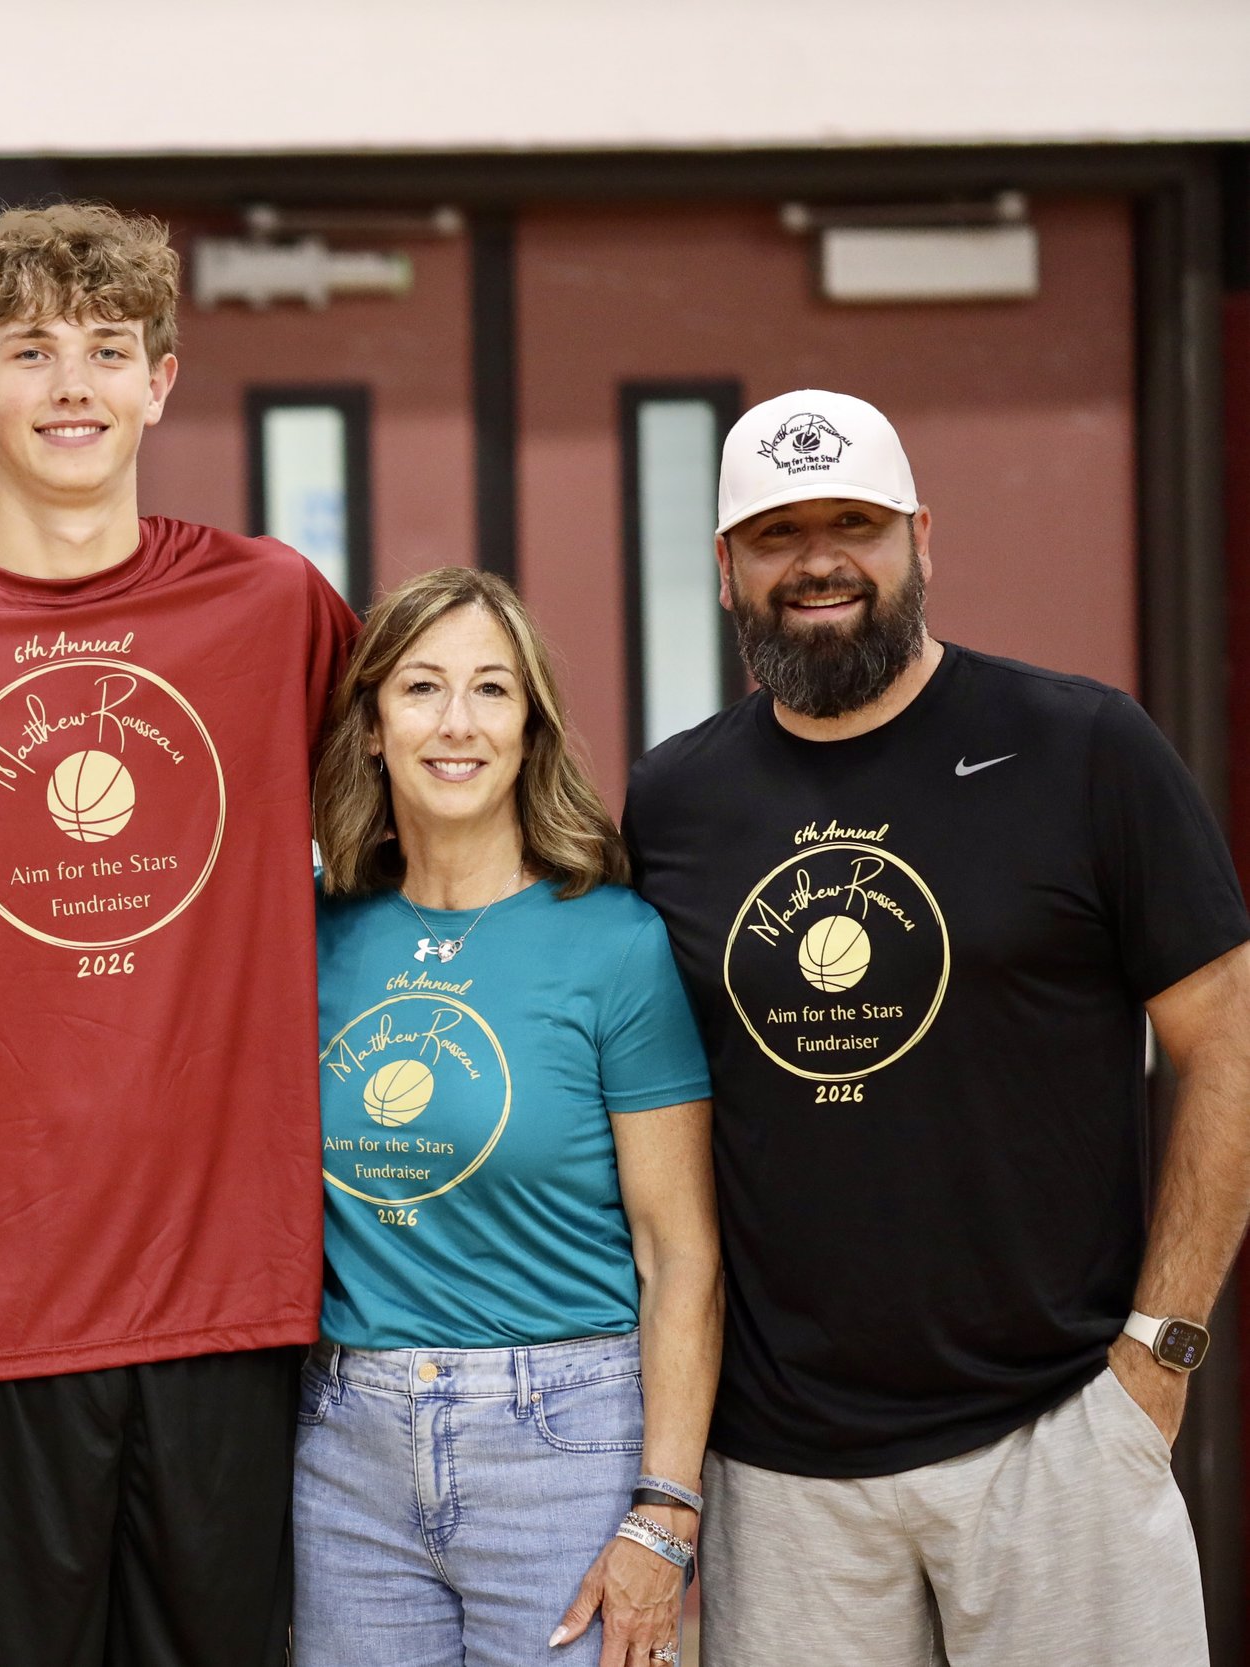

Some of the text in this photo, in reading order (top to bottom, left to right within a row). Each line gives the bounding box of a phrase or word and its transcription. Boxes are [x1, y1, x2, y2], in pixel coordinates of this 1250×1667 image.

[776, 455, 840, 469] Aim for the Stars
[788, 464, 830, 475] Fundraiser
[14, 631, 134, 664] 6th Annual
[91, 673, 185, 765] Rousseau
[794, 820, 889, 844] 6th Annual
[10, 852, 178, 886] Aim for the Stars
[51, 892, 151, 918] Fundraiser
[748, 856, 915, 946] Matthew Rousseau
[77, 952, 135, 978] 2026
[386, 970, 474, 996] 6th Annual
[766, 1003, 903, 1024] Aim for the Stars
[327, 1008, 481, 1082] Matthew Rousseau
[797, 1035, 879, 1052] Fundraiser
[815, 1084, 864, 1104] 2026
[324, 1136, 454, 1155] Aim for the Stars
[354, 1164, 431, 1180] Fundraiser
[378, 1208, 419, 1226] 2026
